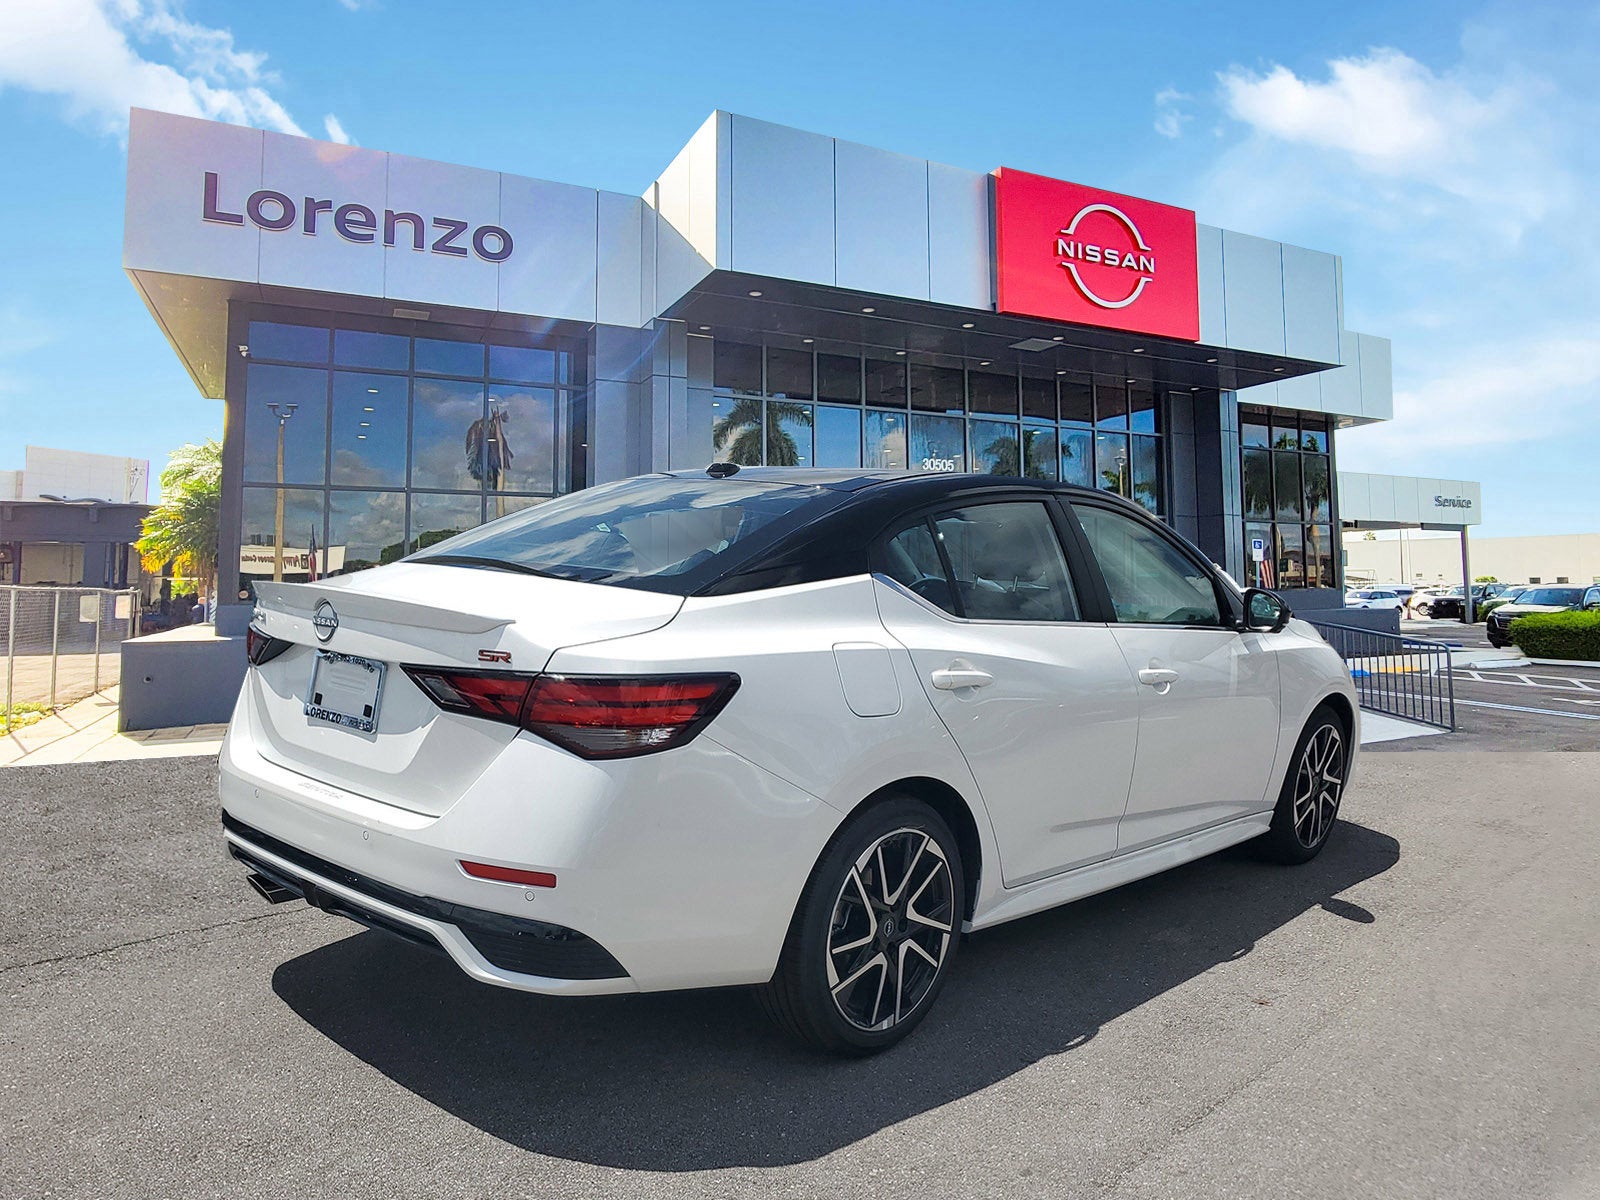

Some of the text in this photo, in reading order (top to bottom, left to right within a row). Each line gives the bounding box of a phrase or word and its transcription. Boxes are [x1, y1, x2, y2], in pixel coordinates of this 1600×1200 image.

[203, 171, 514, 262] Lorenzo
[1057, 238, 1155, 273] NISSAN
[922, 457, 955, 472] 30505
[1434, 495, 1472, 509] Service
[478, 649, 512, 663] SR
[305, 705, 342, 724] LORENZO
